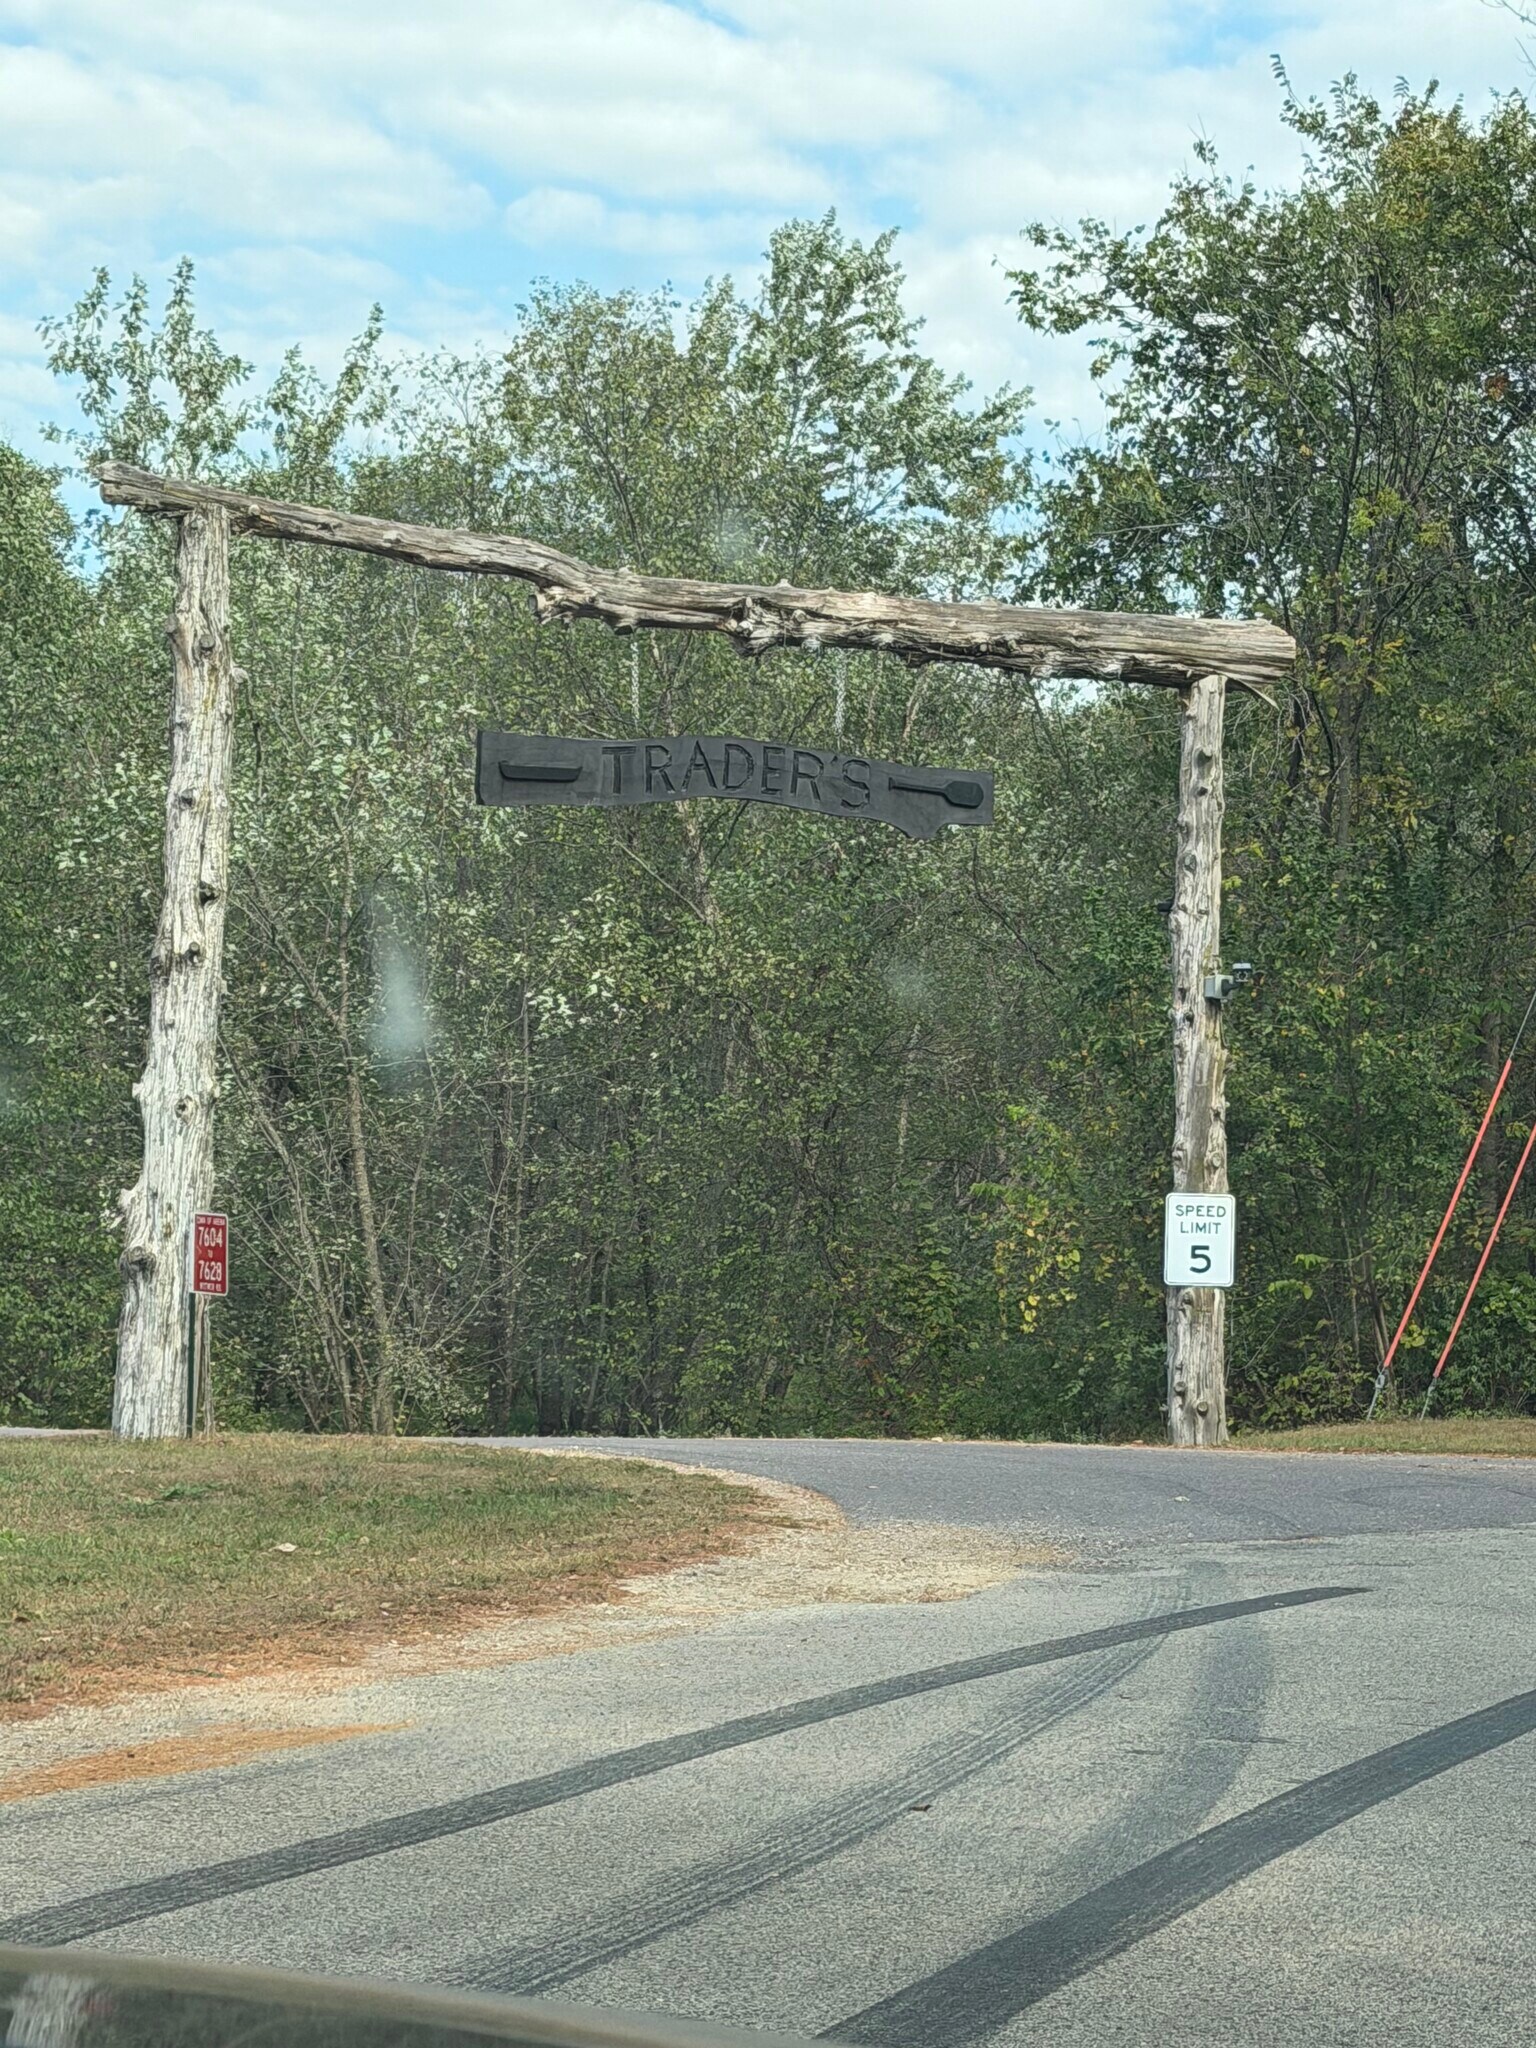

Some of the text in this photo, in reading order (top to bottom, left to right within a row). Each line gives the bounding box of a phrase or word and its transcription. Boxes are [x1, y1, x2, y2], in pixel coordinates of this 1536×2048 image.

[601, 740, 871, 811] TRADER'S
[1175, 1204, 1227, 1218] SPEED
[198, 1227, 223, 1248] 7604
[1180, 1221, 1222, 1235] LIMIT
[1189, 1245, 1212, 1274] 5
[198, 1260, 222, 1282] 7628
